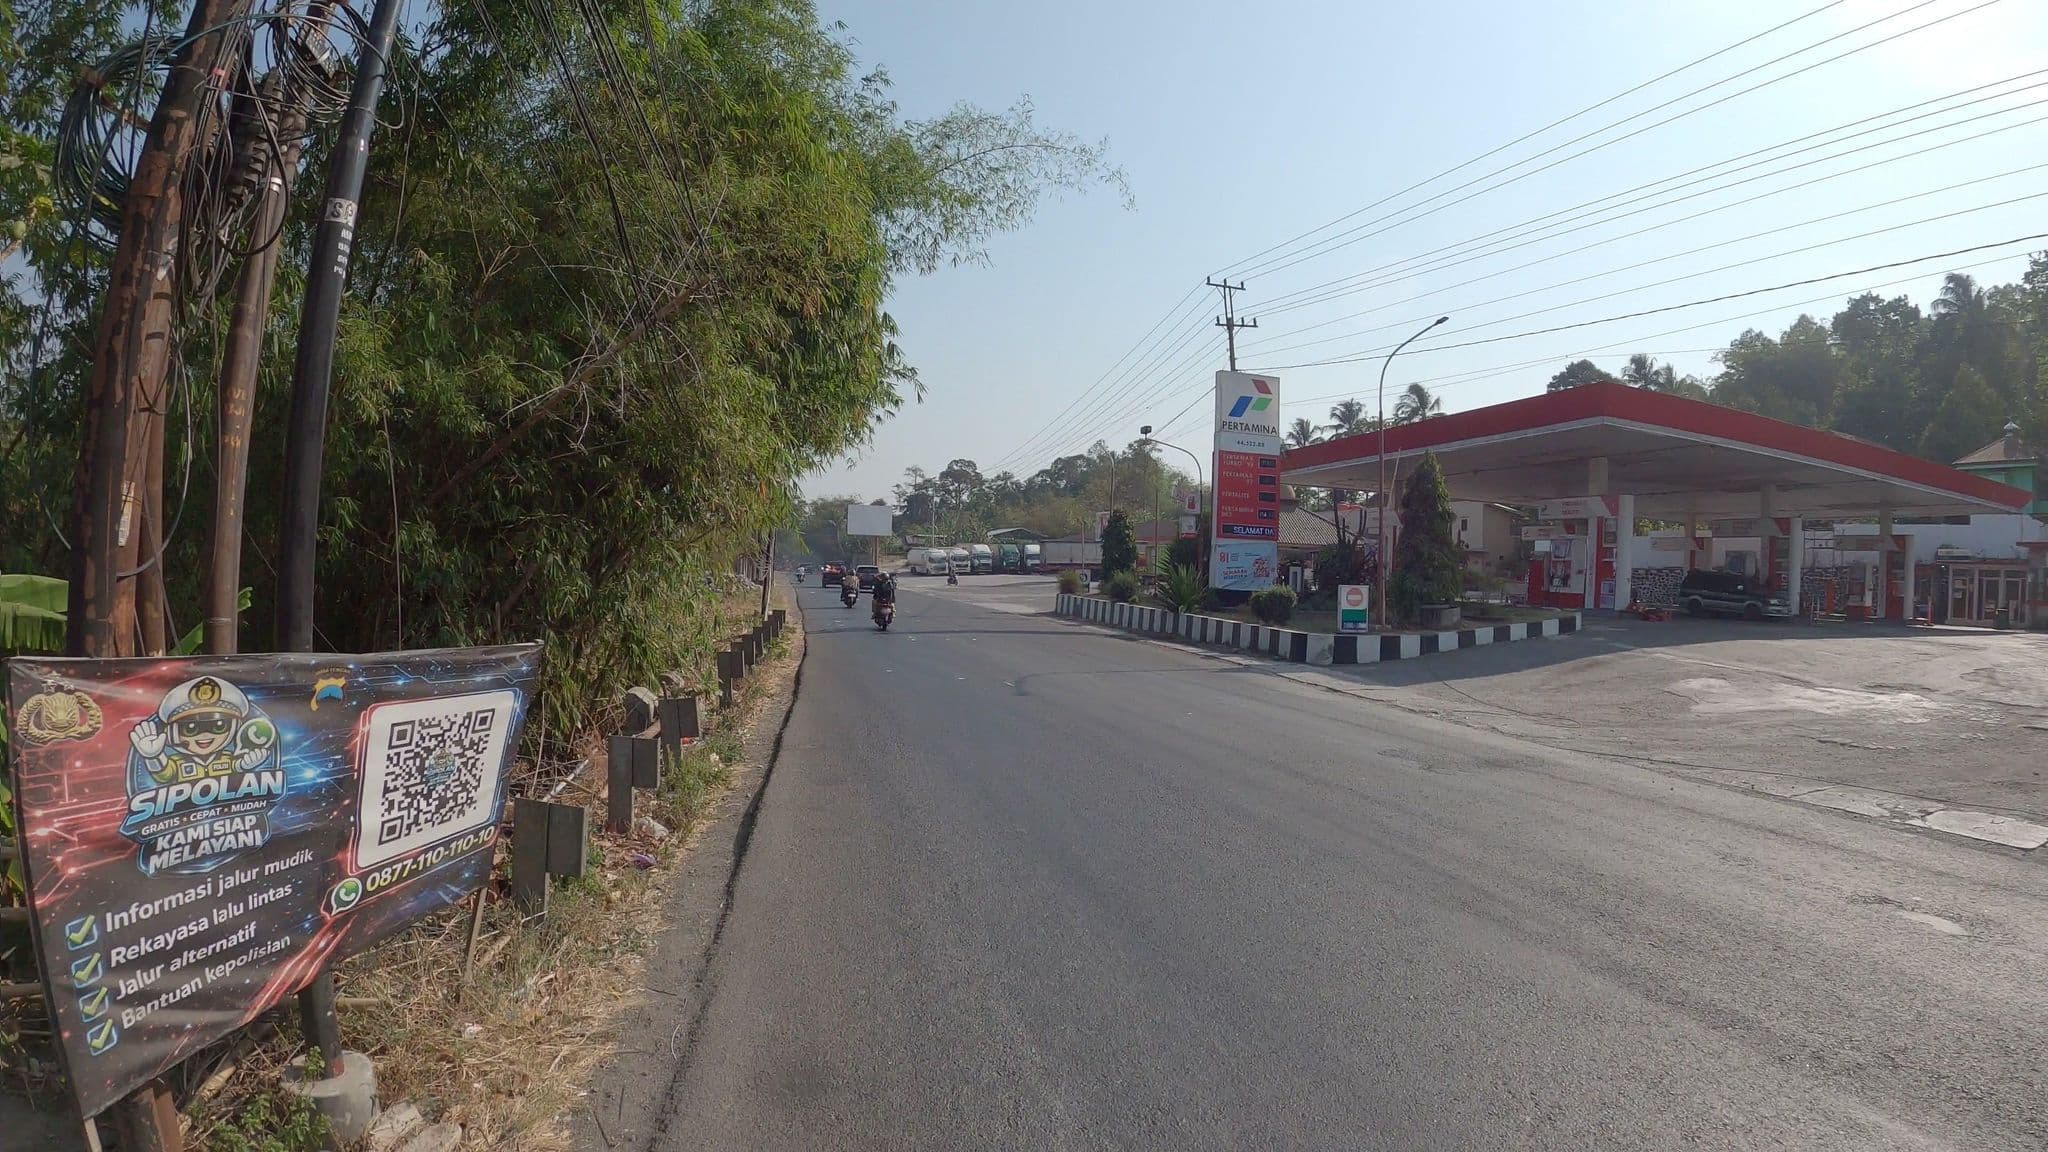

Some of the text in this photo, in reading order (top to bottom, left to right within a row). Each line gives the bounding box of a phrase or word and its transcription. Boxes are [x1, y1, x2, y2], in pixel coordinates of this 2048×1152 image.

[1222, 420, 1278, 435] PERTAMINA
[1233, 526, 1264, 535] SELAMAT
[126, 771, 283, 826] SIPOLAN
[141, 800, 266, 836] GRATIS CEPAT MUDAH
[149, 829, 263, 874] MELAYANI
[156, 815, 257, 852] KAMI SIAP
[366, 825, 495, 892] 0877-110-110-10
[105, 849, 313, 932] Informasi jalur mudik
[110, 883, 293, 968] Rekayasa lalu lintas
[116, 921, 257, 1000] Jalur alternatif
[121, 935, 291, 1029] Bantuan kepolisian
